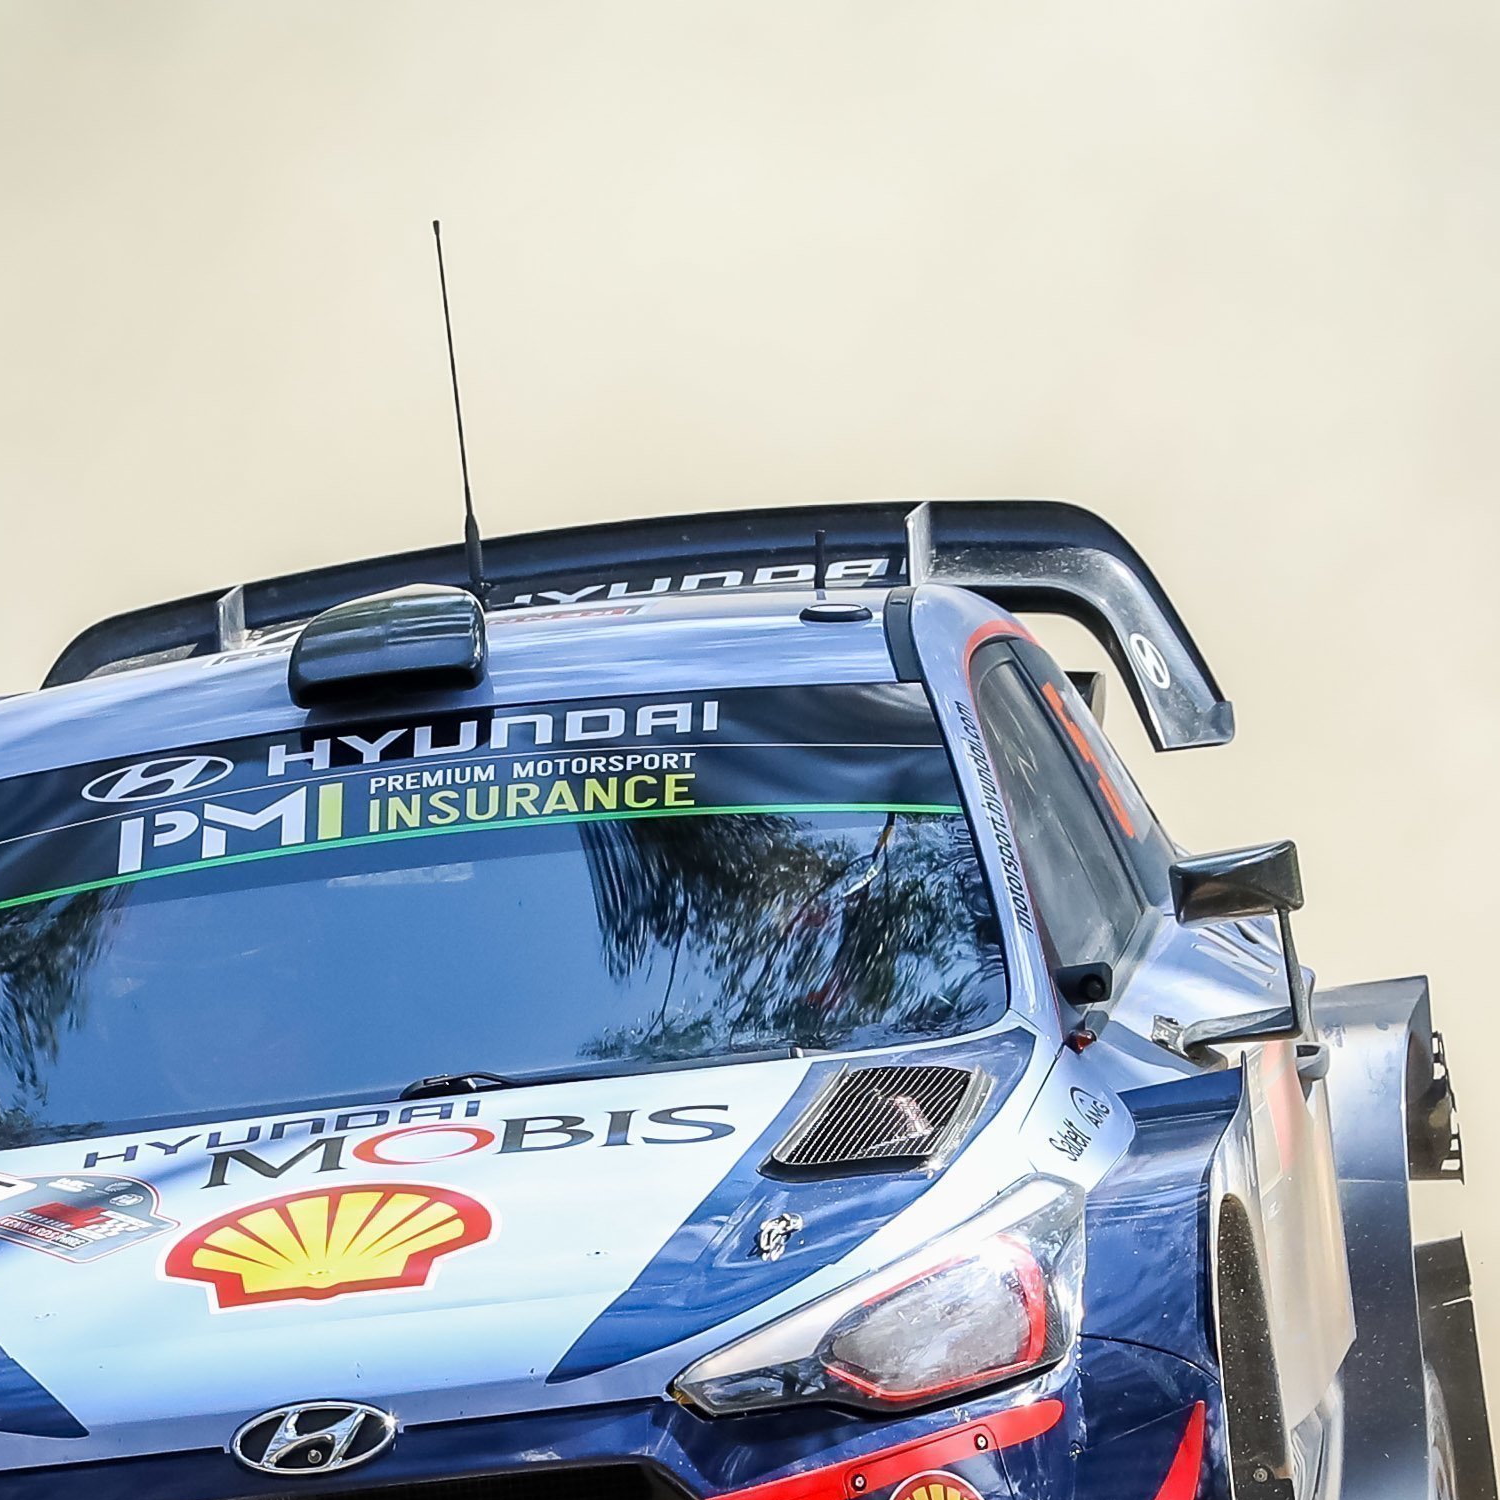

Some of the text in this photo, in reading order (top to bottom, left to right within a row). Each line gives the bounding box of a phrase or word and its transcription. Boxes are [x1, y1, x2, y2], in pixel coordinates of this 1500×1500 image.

[514, 557, 905, 605] YUNDA
[267, 701, 720, 776] HYUNDAI
[368, 773, 696, 832] INSURANCE
[370, 753, 697, 793] PREMIUM MOTORSPORT
[117, 782, 343, 874] PMI
[954, 700, 1034, 932] motorsport.hyundai.com
[84, 1100, 480, 1168] HYUNDAI
[201, 1104, 736, 1190] MOBIS
[1048, 1117, 1092, 1162] Sabelt
